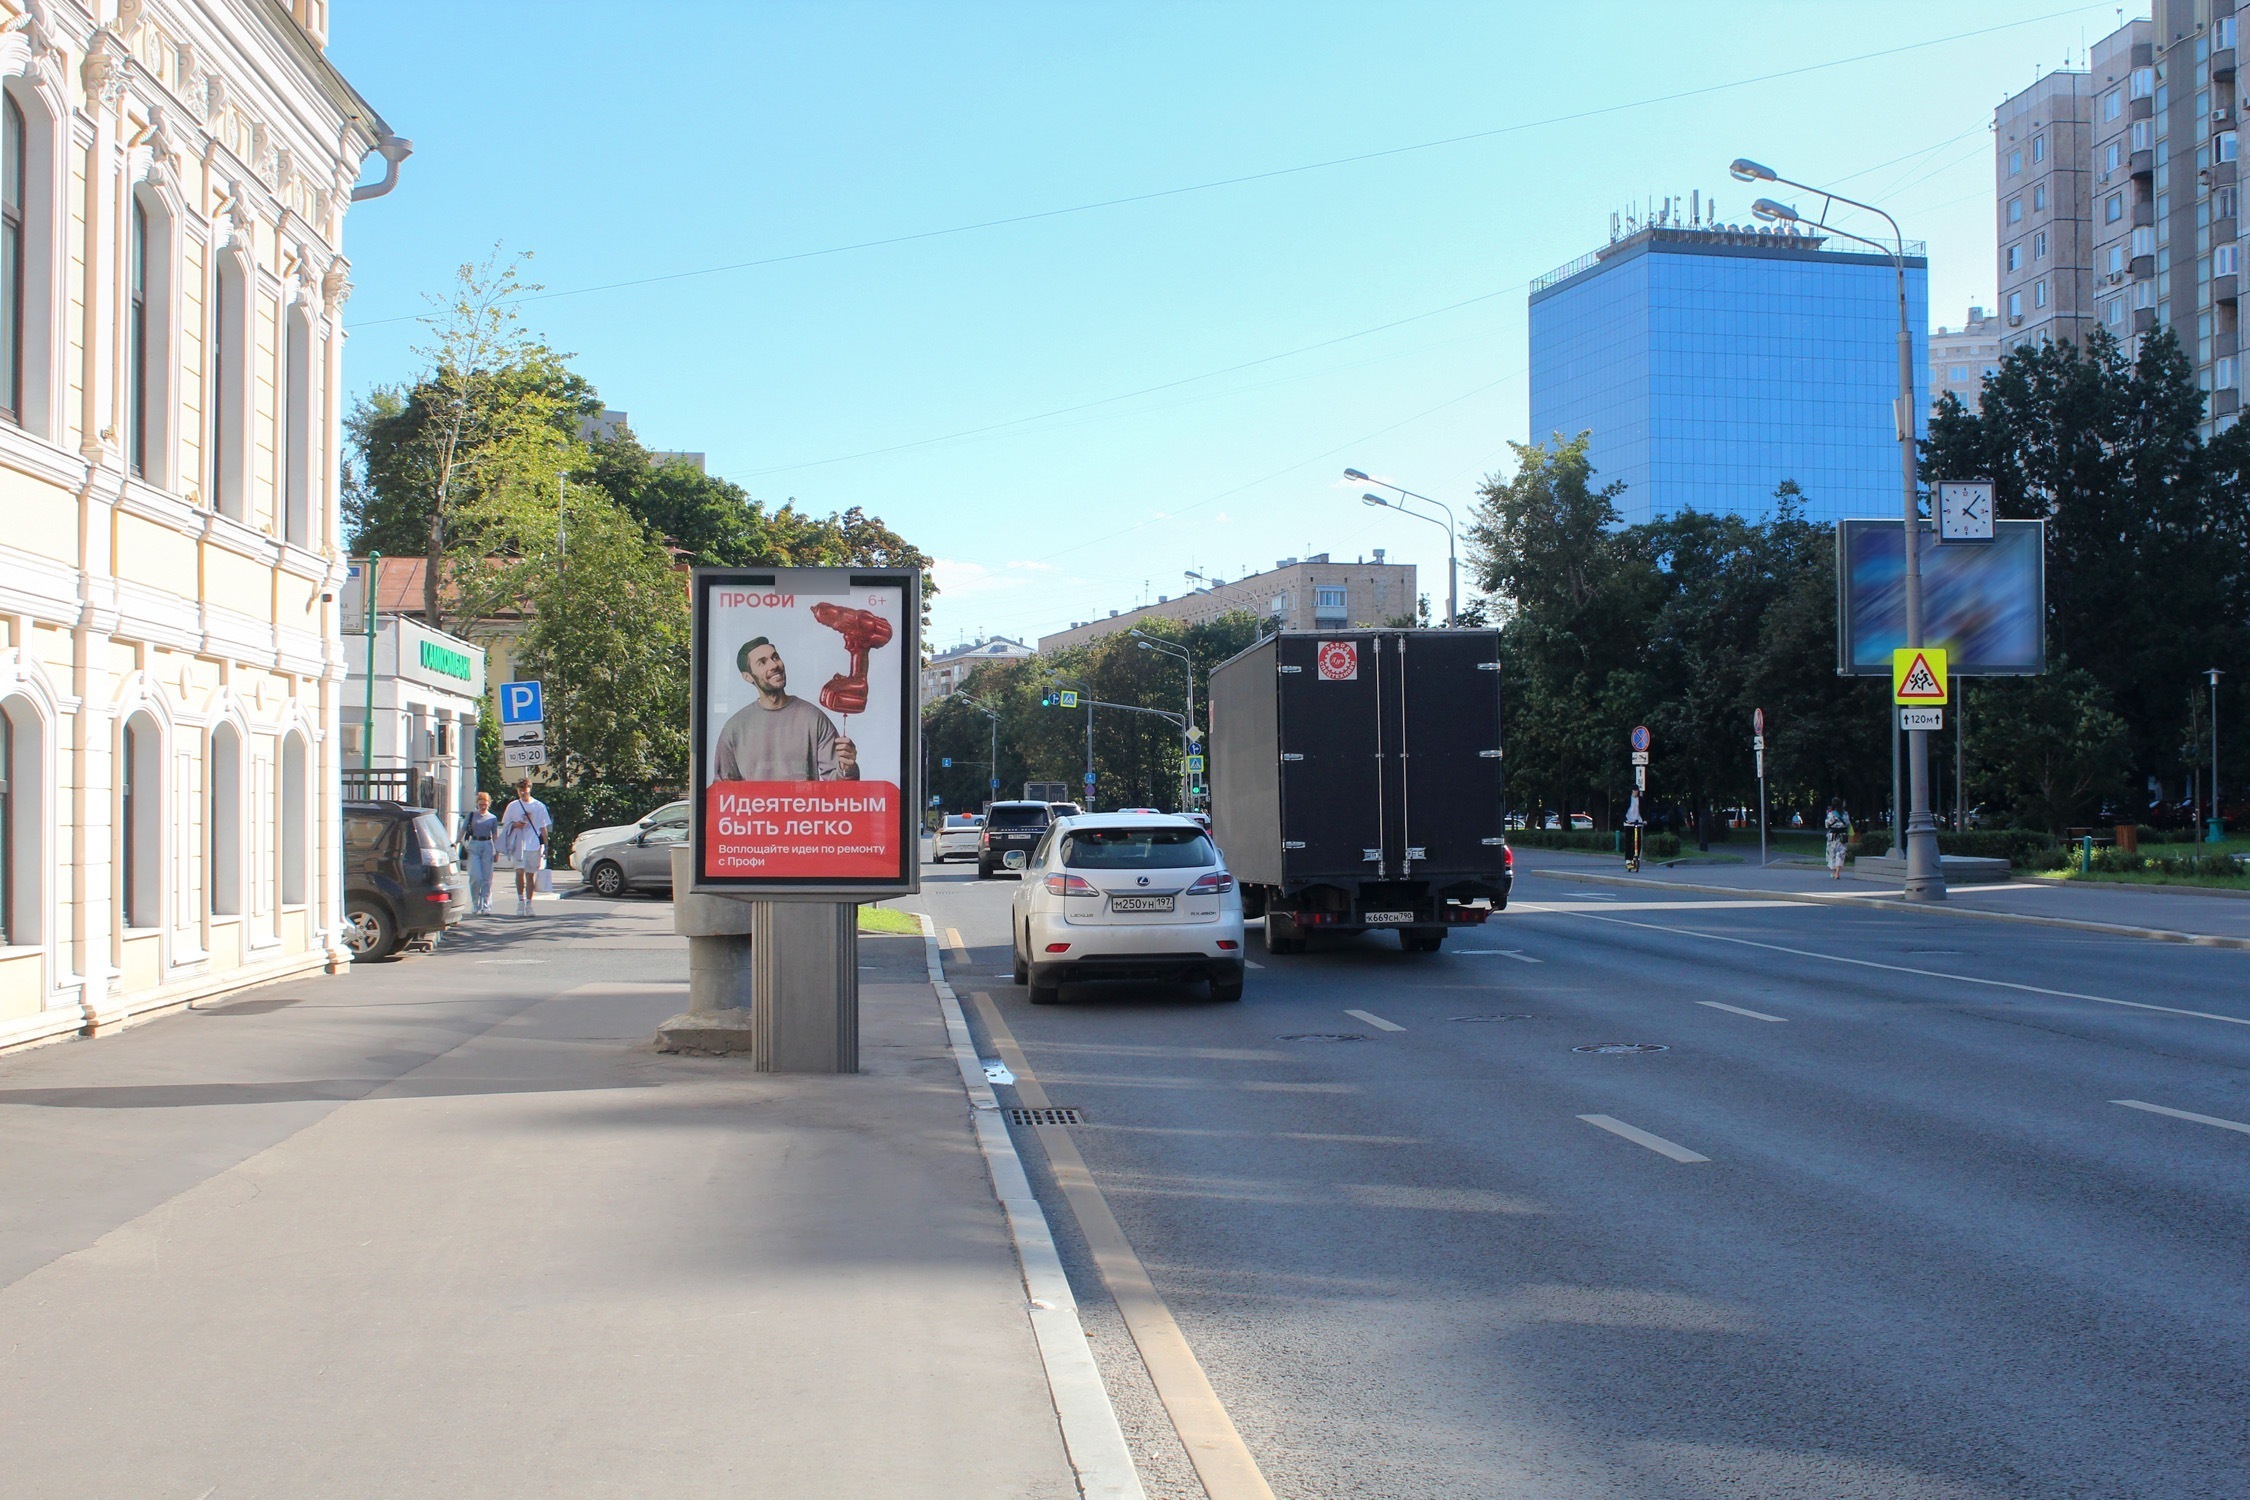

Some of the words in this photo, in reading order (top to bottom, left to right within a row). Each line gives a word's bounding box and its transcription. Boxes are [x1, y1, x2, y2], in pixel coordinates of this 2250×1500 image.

[719, 592, 795, 608] ПРОФИ
[868, 594, 887, 606] 6+
[1325, 642, 1351, 652] ЗАВОД
[420, 640, 471, 682] КАМКОМБАНК
[1319, 660, 1356, 679] СПЕЦТЕХНИКИ
[511, 686, 534, 719] P
[518, 752, 526, 760] 15
[528, 750, 541, 760] 20
[719, 794, 886, 816] Идеятельным
[718, 816, 780, 836] быть
[784, 819, 853, 836] легко
[718, 844, 790, 854] Воплощайте
[792, 846, 818, 854] идеи
[821, 846, 835, 854] по
[837, 846, 885, 854] ремонту
[727, 857, 765, 867] Профи
